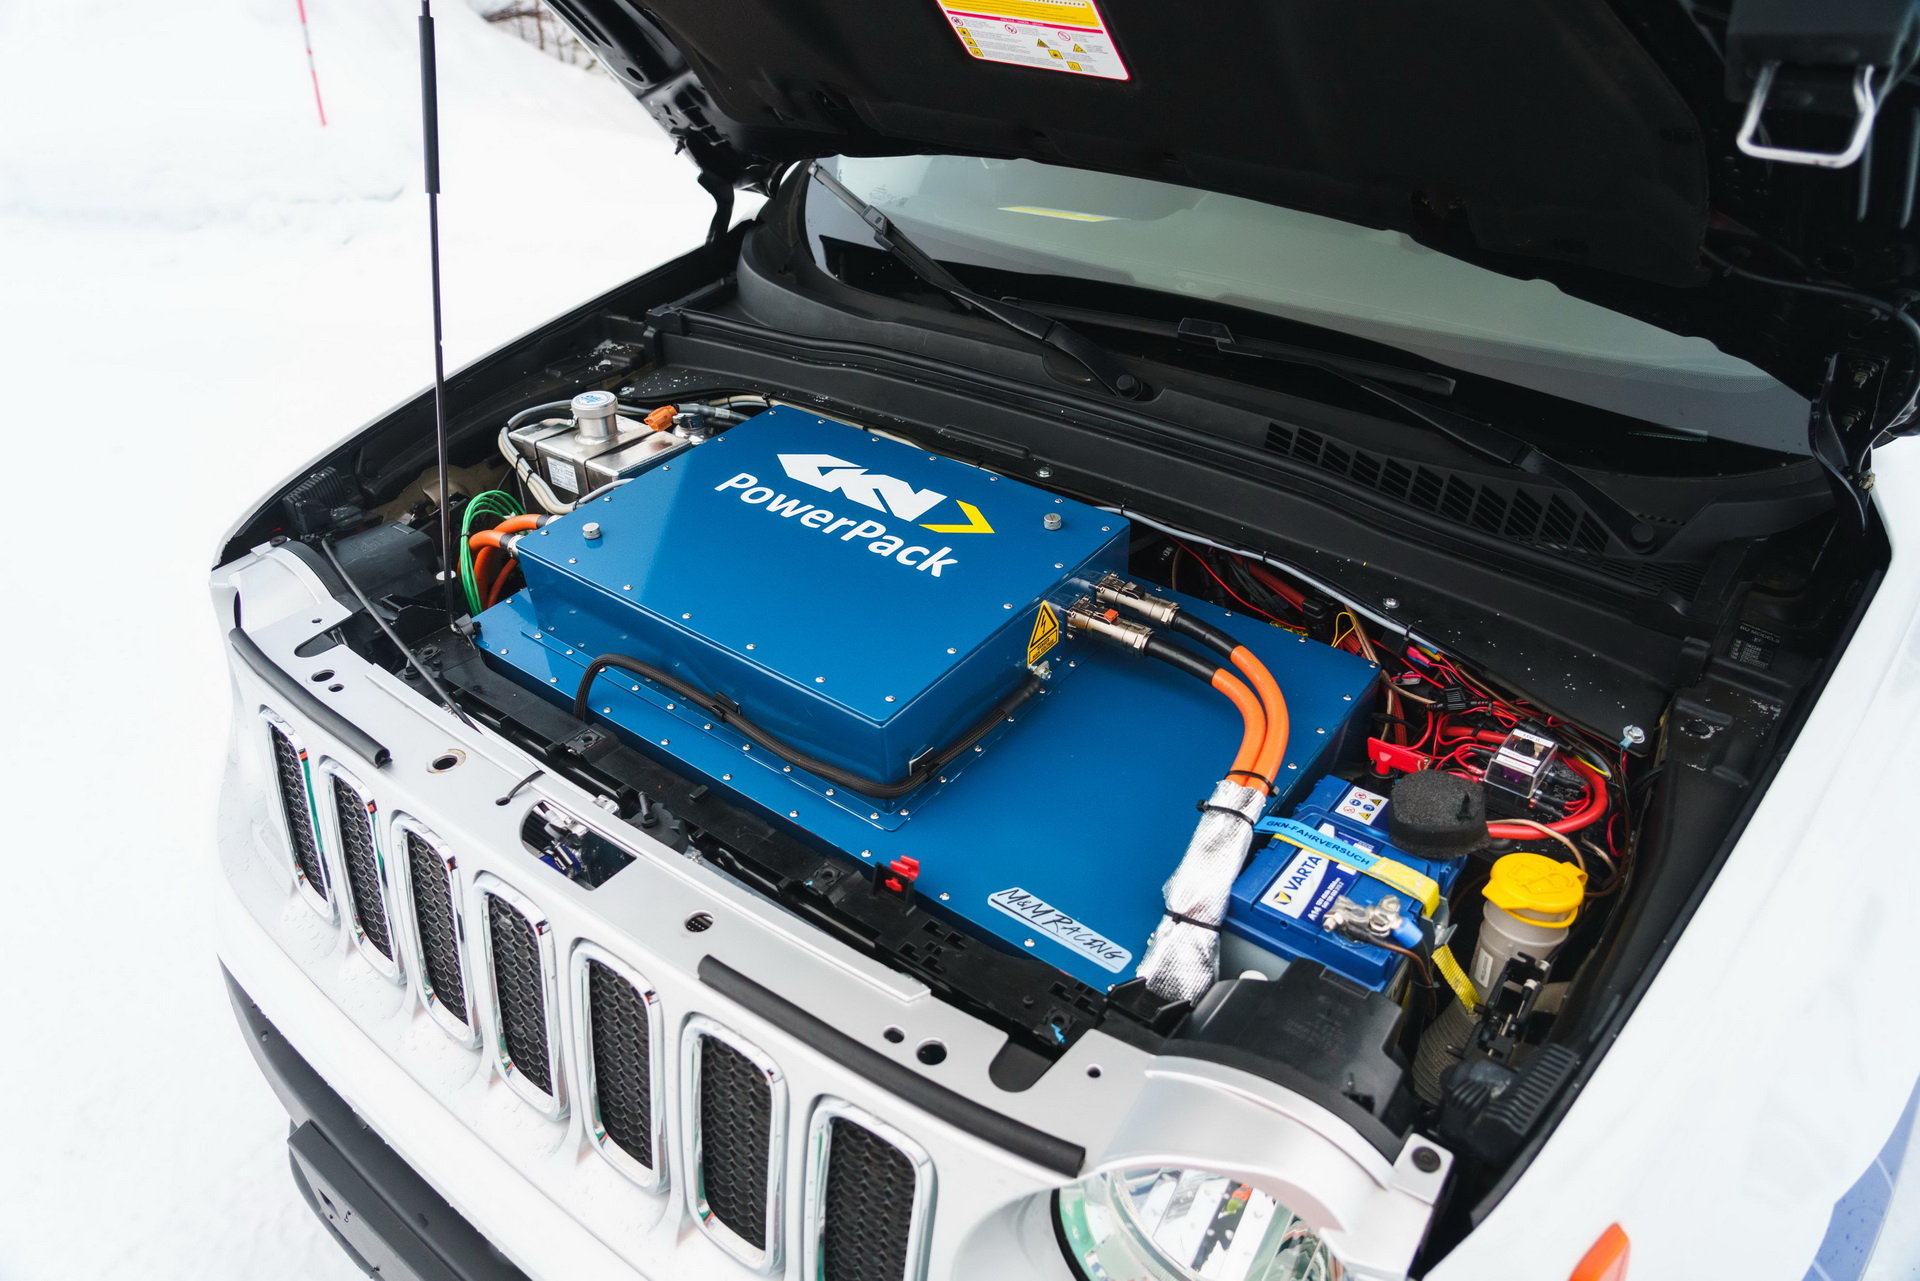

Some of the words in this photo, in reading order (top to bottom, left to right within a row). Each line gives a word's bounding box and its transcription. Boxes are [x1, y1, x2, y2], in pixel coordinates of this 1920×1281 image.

[714, 472, 959, 578] PowerPack
[1266, 820, 1371, 866] GKN-FAHRVERSUCH
[1283, 854, 1323, 892] VARTA
[996, 888, 1056, 919] M&M
[1041, 913, 1126, 960] RACING
